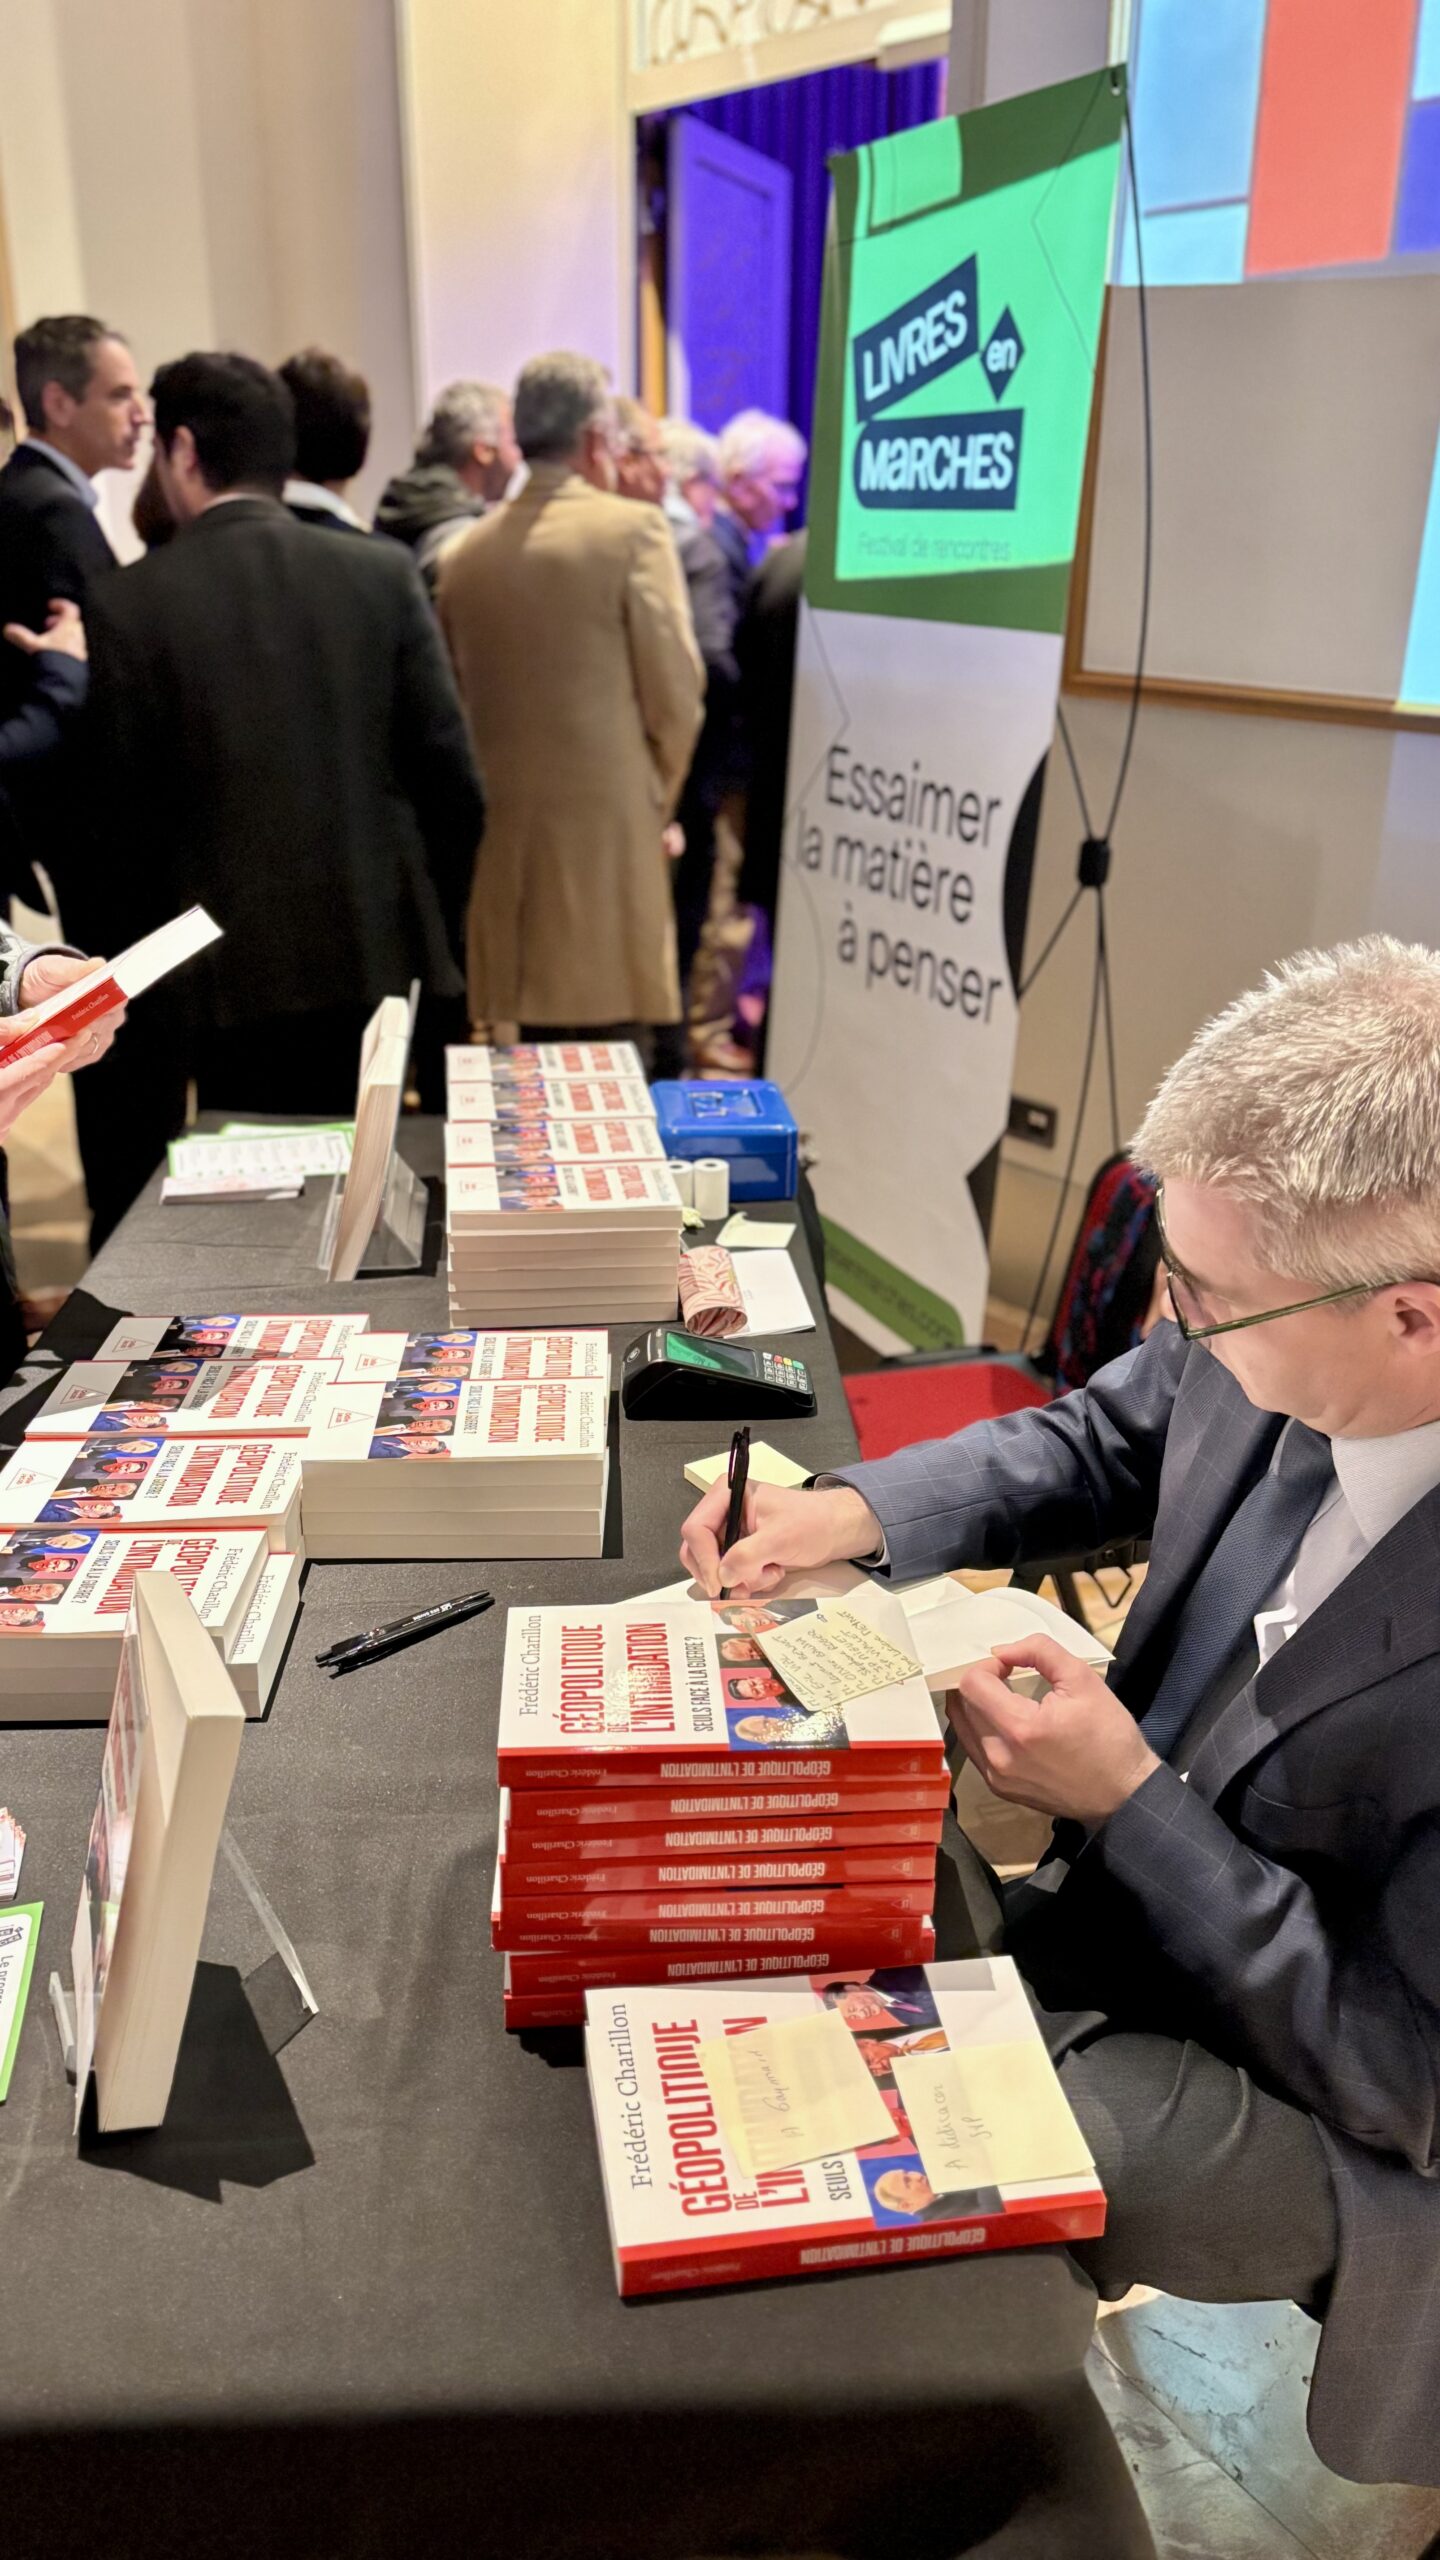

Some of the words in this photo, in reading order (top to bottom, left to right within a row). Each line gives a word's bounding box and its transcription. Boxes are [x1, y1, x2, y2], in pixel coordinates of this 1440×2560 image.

[862, 289, 968, 401] LIVRES
[986, 337, 1017, 373] en
[826, 744, 1002, 848] Essaimer
[796, 807, 822, 871] la
[831, 837, 974, 924] matière
[838, 901, 858, 964] à
[866, 929, 1002, 1024] penser
[208, 1365, 261, 1419] L'INTIMIDATION
[253, 1365, 307, 1418] GÉOPOLITIQUE
[488, 1385, 522, 1443] L'INTIMIDATION
[534, 1384, 572, 1443] GÉOPOLITIQUE
[274, 1451, 298, 1478] Frédéric
[165, 1445, 226, 1507] L'INTIMIDATION
[215, 1444, 277, 1505] GÉOPOLITIQUE
[259, 1477, 286, 1510] Charillon
[99, 1540, 120, 1554] SEULS
[215, 1547, 244, 1582] Frédéric
[73, 1580, 98, 1599] GUERRE
[248, 1574, 275, 1612] Frédéric
[198, 1578, 229, 1620] Charillon
[231, 1611, 262, 1656] Charillon
[520, 1615, 542, 1665] Charillon
[685, 1643, 707, 1668] GUERRE
[552, 1624, 606, 1734] GÉOPOLITIQUE
[626, 1623, 675, 1732] L'INTIMIDATION
[685, 1678, 709, 1687] À
[688, 1669, 708, 1678] LA
[518, 1667, 540, 1716] Frédéric
[690, 1687, 711, 1705] FACE
[607, 1721, 629, 1733] DE
[692, 1707, 714, 1732] SEULS
[525, 1769, 568, 1777] Charillon
[571, 1768, 607, 1777] Frédéric
[661, 1762, 739, 1778] L'INTIMIDATION
[742, 1762, 755, 1776] DE
[758, 1760, 831, 1778] GÉOPOLITIQUE
[671, 1797, 748, 1813] L'INTIMIDATION
[751, 1796, 764, 1809] DE
[766, 1793, 838, 1810] GÉOPOLITIQUE
[536, 1807, 580, 1816] Charillon
[665, 1830, 743, 1847] L'INTIMIDATION
[745, 1829, 758, 1843] DE
[761, 1827, 832, 1843] GÉOPOLITIQUE
[532, 1840, 575, 1849] Charillon
[526, 1874, 568, 1883] Charillon
[659, 1865, 736, 1882] L'INTIMIDATION
[738, 1864, 751, 1879] DE
[754, 1862, 825, 1879] GÉOPOLITIQUE
[527, 1911, 568, 1920] Charillon
[659, 1902, 734, 1918] L'INTIMIDATION
[738, 1902, 750, 1914] DE
[753, 1899, 824, 1915] GÉOPOLITIQUE
[650, 1928, 726, 1943] L'INTIMIDATION
[728, 1928, 741, 1942] DE
[743, 1927, 815, 1943] GÉOPOLITIQUE
[667, 1959, 742, 1977] L'INTIMIDATION
[745, 1958, 757, 1971] DE
[760, 1953, 829, 1969] GÉOPOLITIQUE
[608, 2003, 639, 2097] Charillon
[652, 2019, 733, 2217] GÉOPOLITIQUE
[621, 2101, 653, 2190] Frédéric
[822, 2160, 852, 2202] SEULS
[733, 2191, 760, 2211] DE
[890, 2237, 903, 2254] DE
[906, 2227, 986, 2254] GÉOPOLITIQUE
[800, 2239, 886, 2265] L'INTIMIDATION
